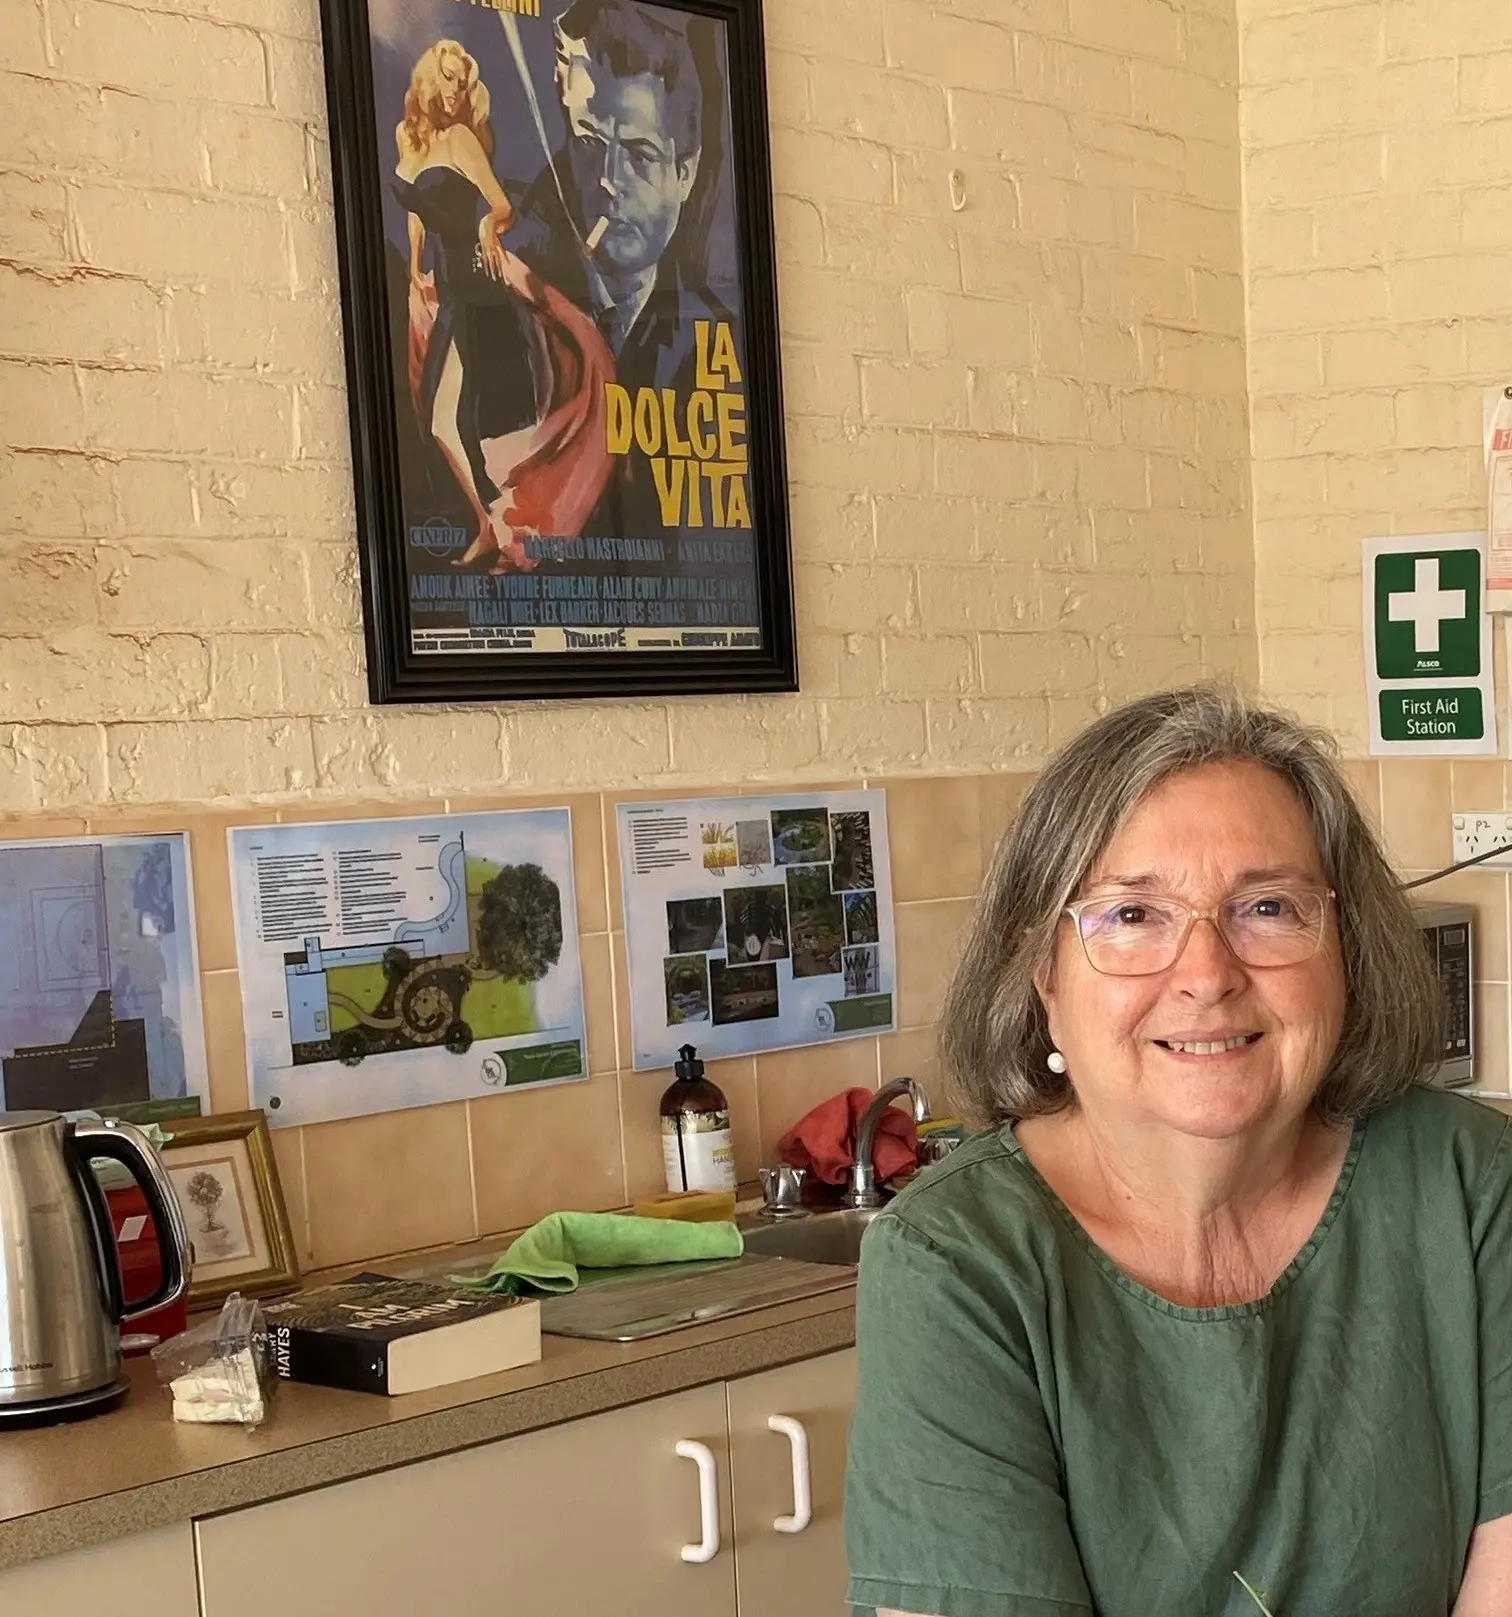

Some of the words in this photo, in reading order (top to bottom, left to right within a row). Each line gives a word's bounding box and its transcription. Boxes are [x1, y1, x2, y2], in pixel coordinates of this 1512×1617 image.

[695, 320, 743, 390] LA
[605, 382, 748, 461] DOLCE
[650, 457, 752, 529] VITA
[1401, 699, 1432, 715] First
[1435, 697, 1459, 714] Aid
[1406, 719, 1456, 735] Station
[277, 1327, 291, 1378] HAYES
